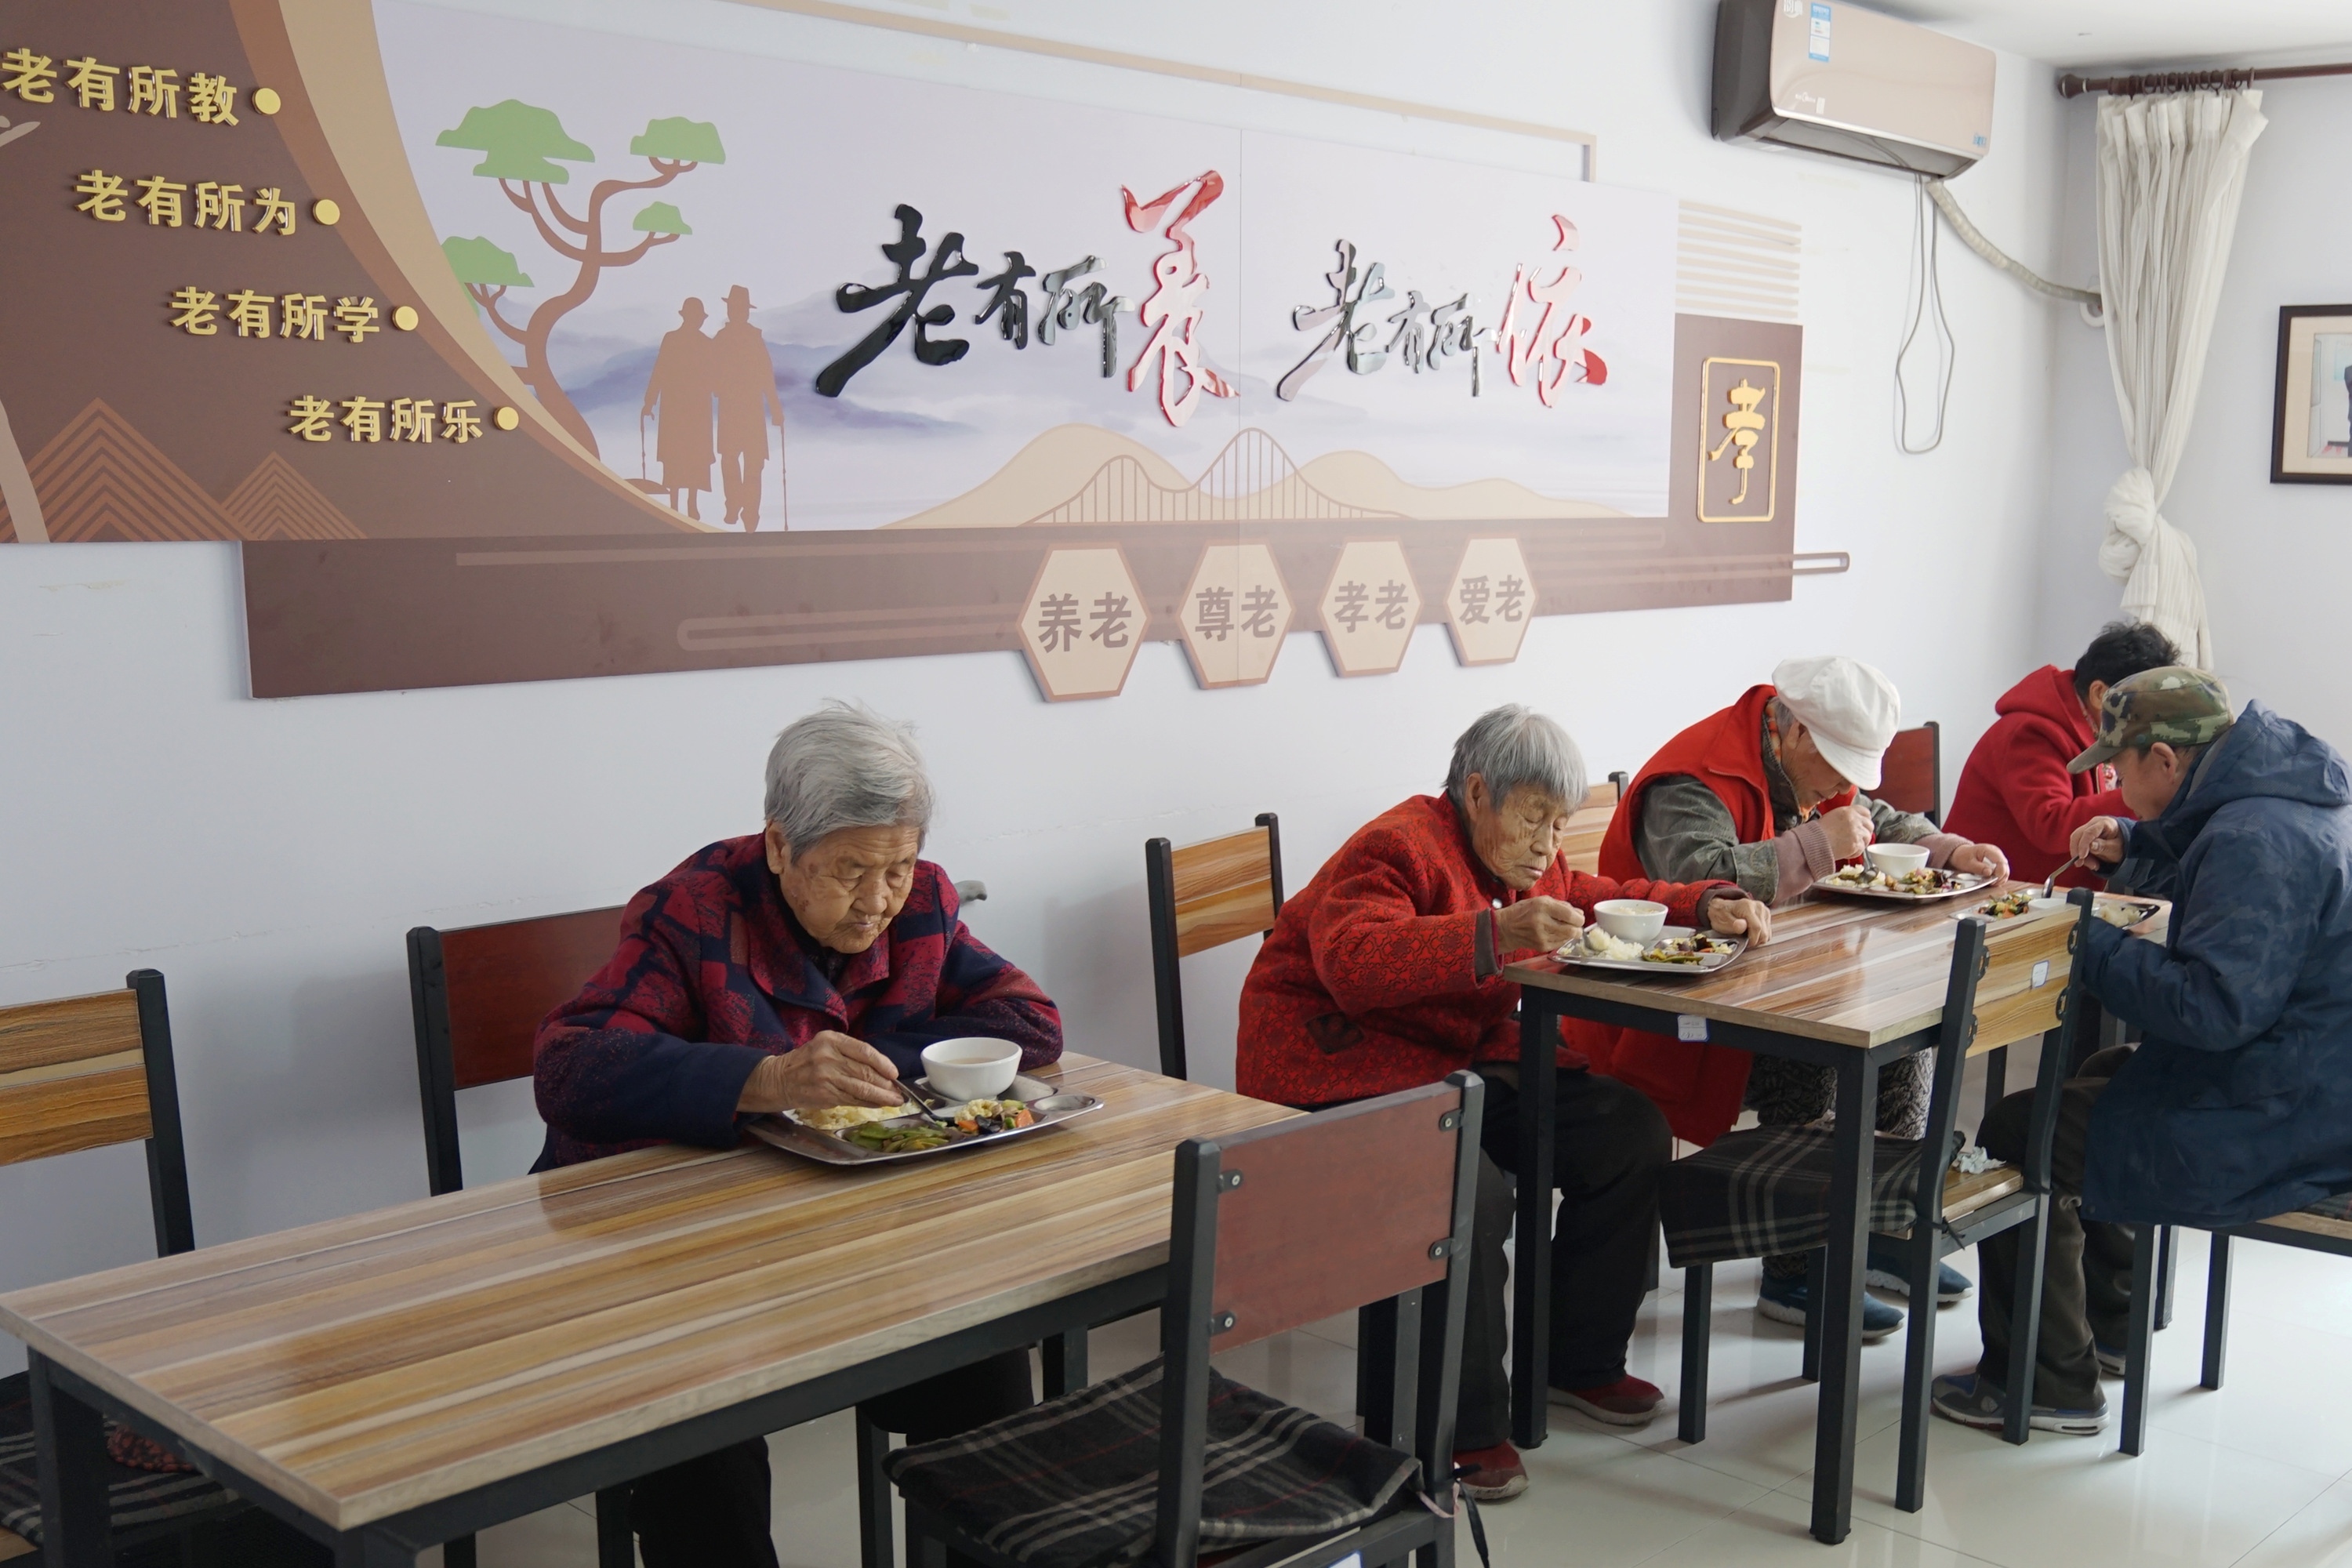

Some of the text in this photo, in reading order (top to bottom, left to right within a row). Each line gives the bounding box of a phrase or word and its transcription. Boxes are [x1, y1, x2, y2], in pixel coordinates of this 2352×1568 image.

[2, 48, 238, 125] 老有所教
[74, 169, 296, 235] 老有所为
[168, 286, 380, 343] 老有所学
[289, 395, 483, 444] 老有所乐
[1707, 378, 1766, 506] 孝
[1038, 591, 1132, 653] 养老
[1195, 584, 1279, 642] 尊老
[1334, 579, 1409, 632] 孝老
[1458, 574, 1526, 626] 爱老
